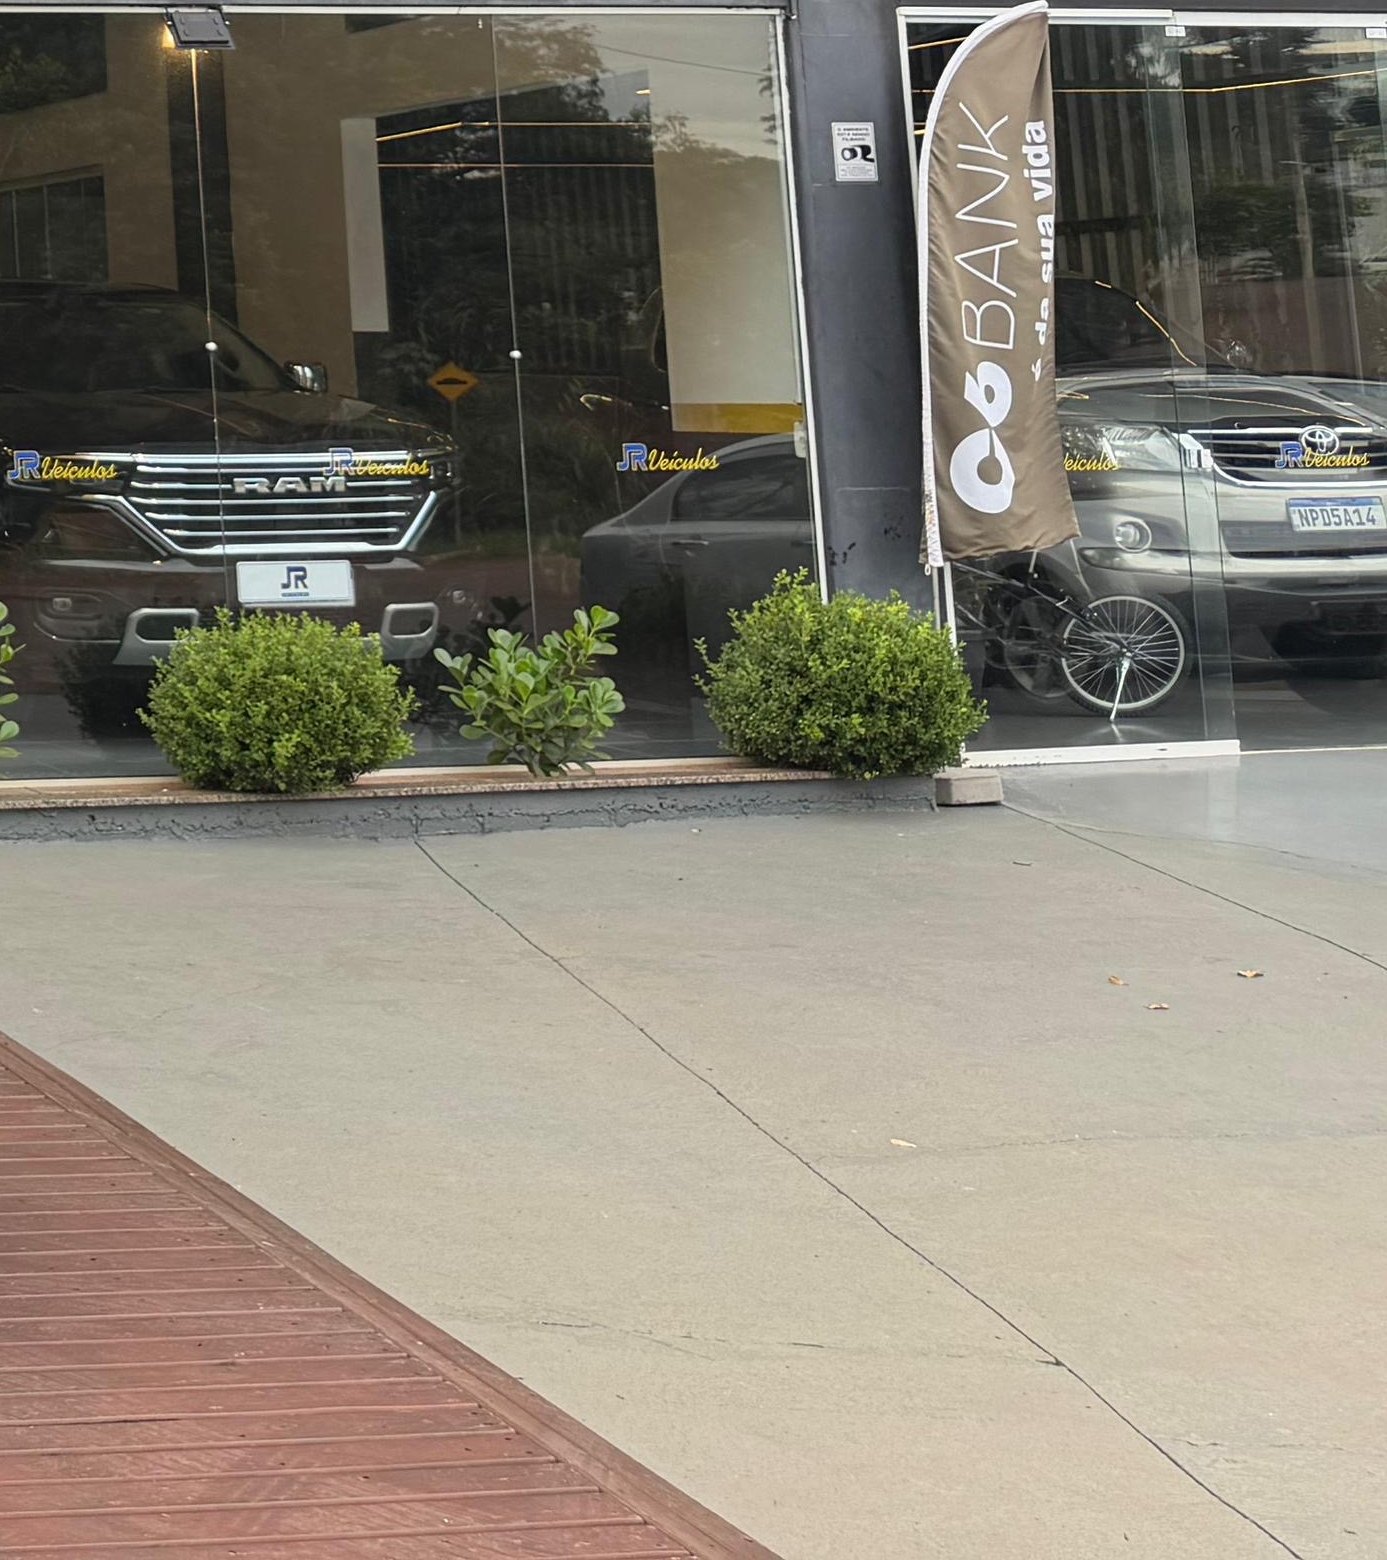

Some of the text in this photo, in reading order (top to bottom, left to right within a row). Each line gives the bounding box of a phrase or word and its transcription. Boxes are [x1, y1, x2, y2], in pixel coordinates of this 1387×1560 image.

[1022, 120, 1053, 202] vida
[1037, 214, 1055, 284] sua
[950, 101, 1019, 514] C6 BANK
[7, 450, 41, 479] JR
[323, 447, 355, 476] JR
[617, 443, 648, 472] JR
[1063, 452, 1120, 471] eículos
[1274, 441, 1304, 469] JR
[233, 476, 346, 493] RAM
[1297, 506, 1377, 528] NPD5A14
[281, 566, 309, 590] JR
